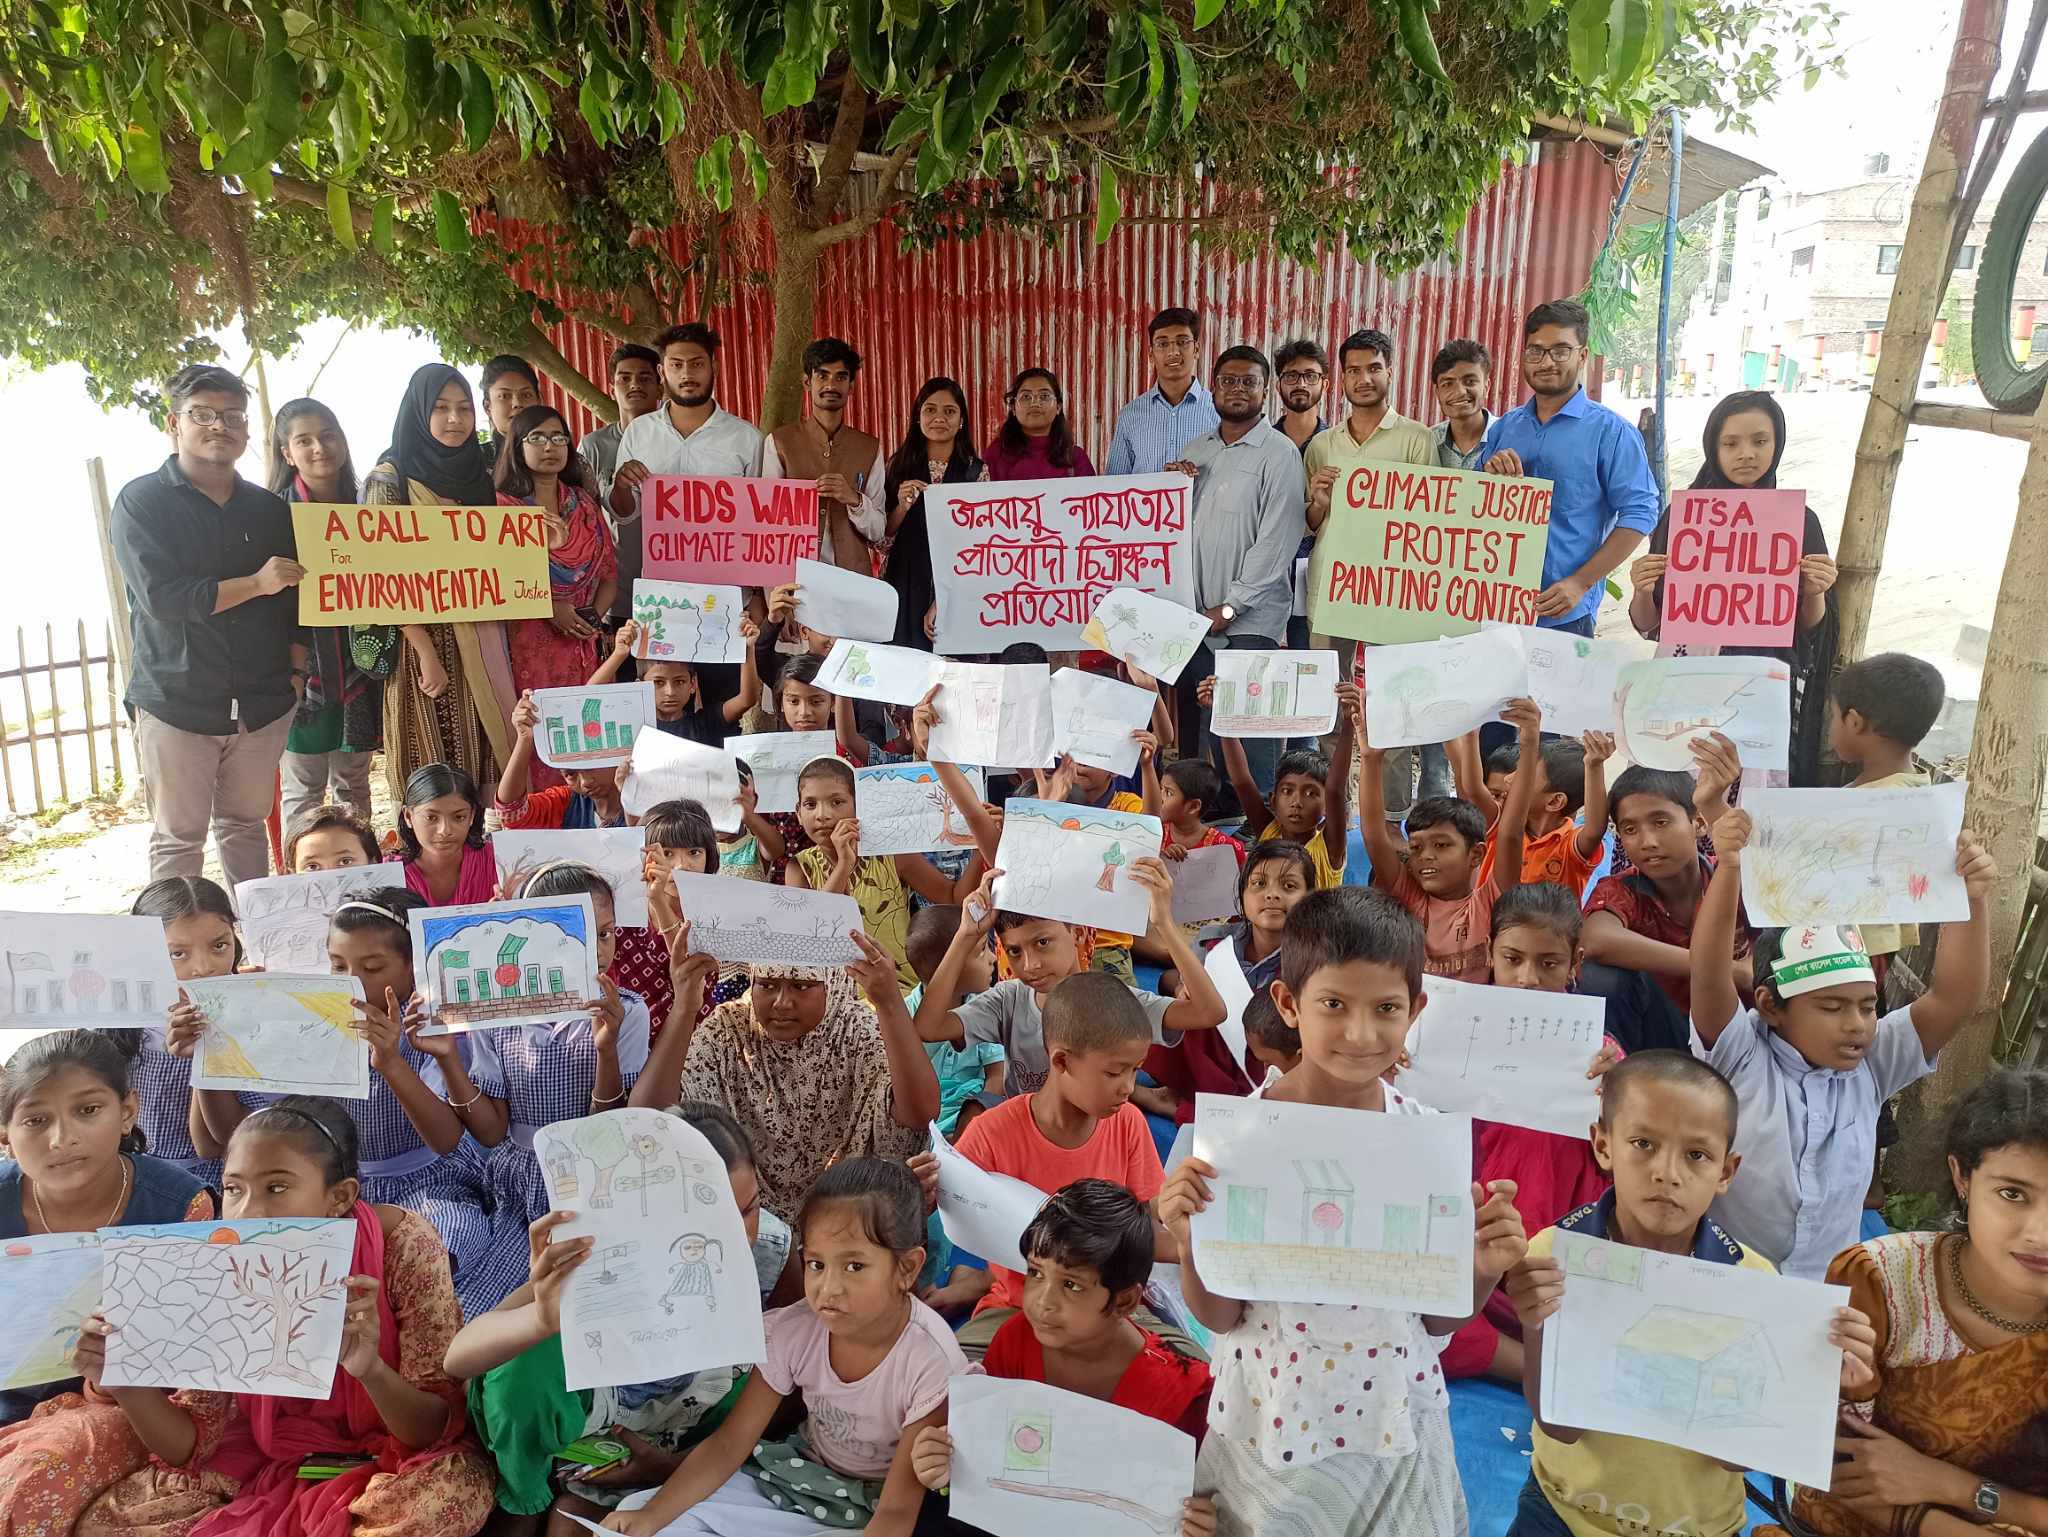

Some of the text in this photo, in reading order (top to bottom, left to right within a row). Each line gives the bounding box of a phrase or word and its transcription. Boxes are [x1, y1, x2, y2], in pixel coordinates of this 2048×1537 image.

[656, 479, 818, 526] KIDS WANT
[947, 493, 1061, 536] জলবায়ু
[1346, 468, 1552, 526] CLIMATE JUSTICE
[1683, 497, 1754, 528] IT'S A
[325, 509, 545, 547] A CALL TO ART
[648, 531, 818, 565] CLIMATE JUSTICE
[1384, 521, 1526, 577] PROTEST
[953, 534, 1068, 584] প্রতিবাদী
[1671, 528, 1798, 576] CHILD
[319, 568, 506, 613] ENVIRONMENTAL
[1329, 561, 1441, 612] PAINTING
[1667, 583, 1795, 626] WORLD
[1562, 1206, 1593, 1228] DAKS
[1711, 1225, 1738, 1256] DAKS
